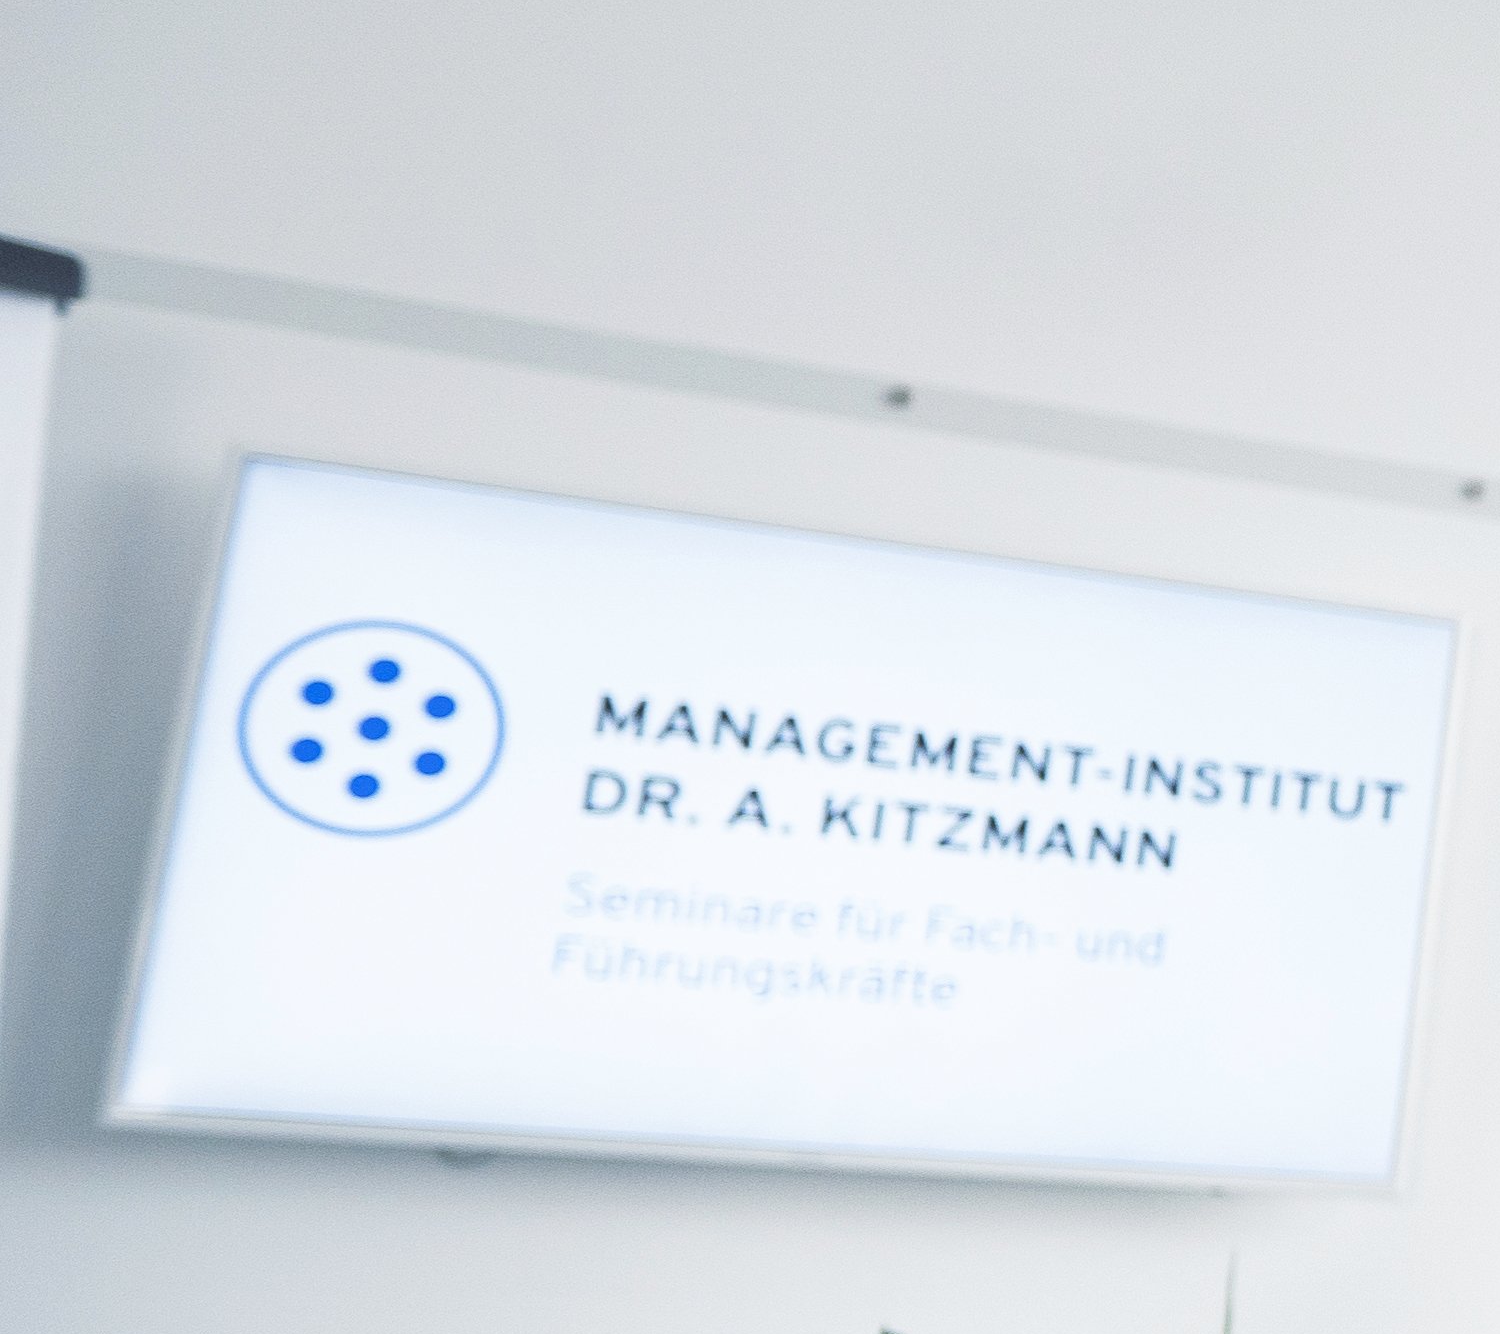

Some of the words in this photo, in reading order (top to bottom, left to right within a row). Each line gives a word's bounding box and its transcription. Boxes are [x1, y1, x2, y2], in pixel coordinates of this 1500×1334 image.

[595, 693, 1409, 824] MANAGEMENT-INSTITUT
[583, 769, 699, 827] DR.
[727, 787, 794, 837] A.
[820, 794, 1181, 873] KITZMANN
[565, 870, 820, 937] Seminare
[836, 898, 911, 944] für
[924, 907, 1059, 955] Fach-
[1077, 925, 1168, 969] und
[551, 934, 960, 1010] Führungskräfte
